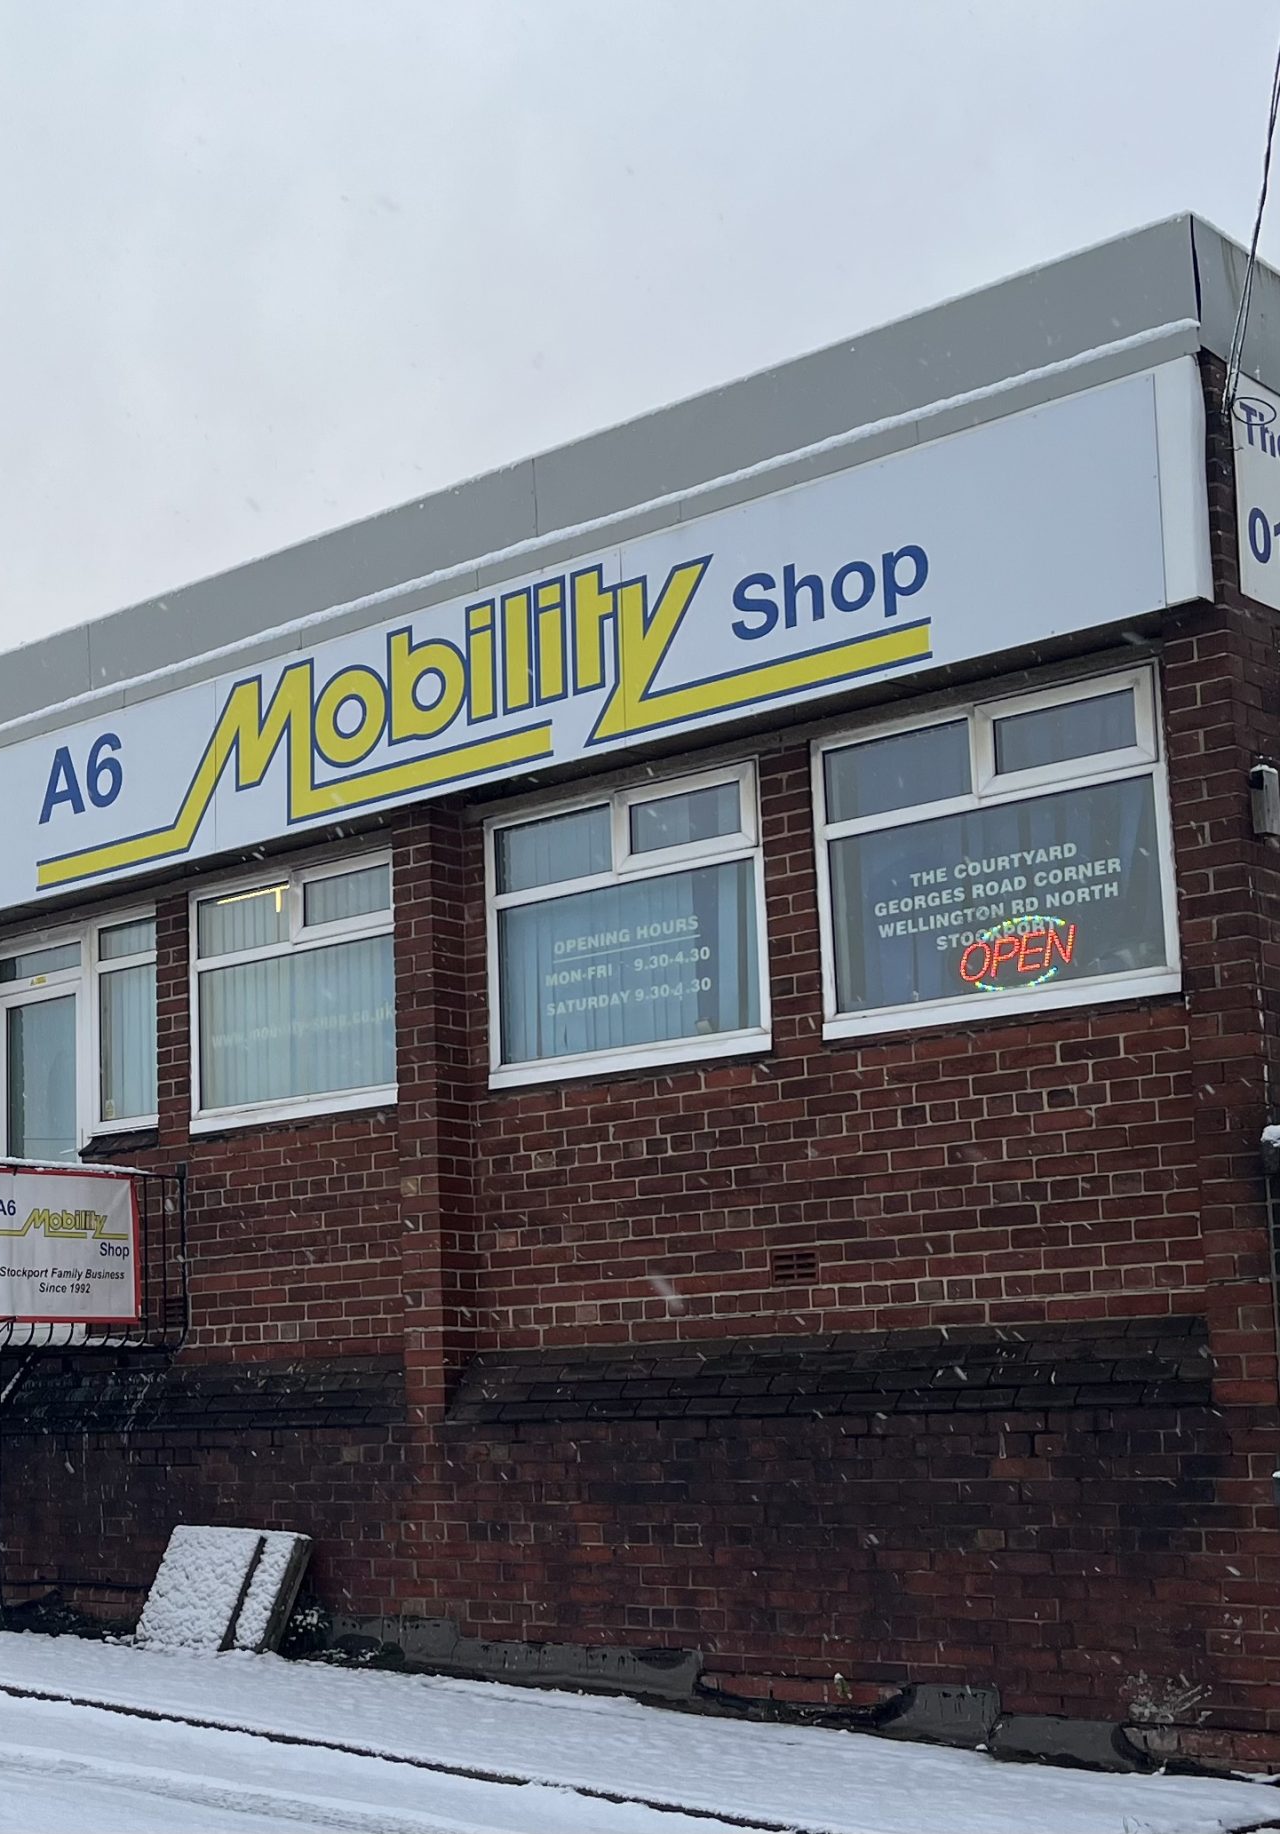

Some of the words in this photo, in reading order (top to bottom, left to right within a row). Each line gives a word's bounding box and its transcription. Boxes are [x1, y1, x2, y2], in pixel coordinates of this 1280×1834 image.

[1239, 400, 1280, 457] Th
[39, 732, 123, 824] A6
[180, 553, 712, 850] Mobility
[731, 543, 929, 640] Shop
[910, 868, 948, 888] THE
[953, 842, 1078, 878] COURTYARD
[874, 892, 966, 918] GEORGES
[971, 876, 1028, 897] ROAD
[1033, 857, 1122, 886] CORNER
[878, 905, 1005, 939] WELLINGTON
[1011, 898, 1039, 915] RD
[1045, 881, 1119, 908] NORTH
[554, 929, 631, 955] OPENING
[636, 915, 700, 939] HOURS
[960, 924, 1077, 982] OPEN
[545, 964, 613, 986] MON-FRI
[546, 990, 631, 1016] SATURDAY
[20, 1208, 109, 1239] Mobility
[100, 1242, 130, 1260] Shop
[0, 1266, 48, 1280] Stockport
[51, 1268, 83, 1281] Family
[85, 1268, 125, 1280] Business
[39, 1282, 67, 1294] Since
[70, 1283, 91, 1294] 1992
